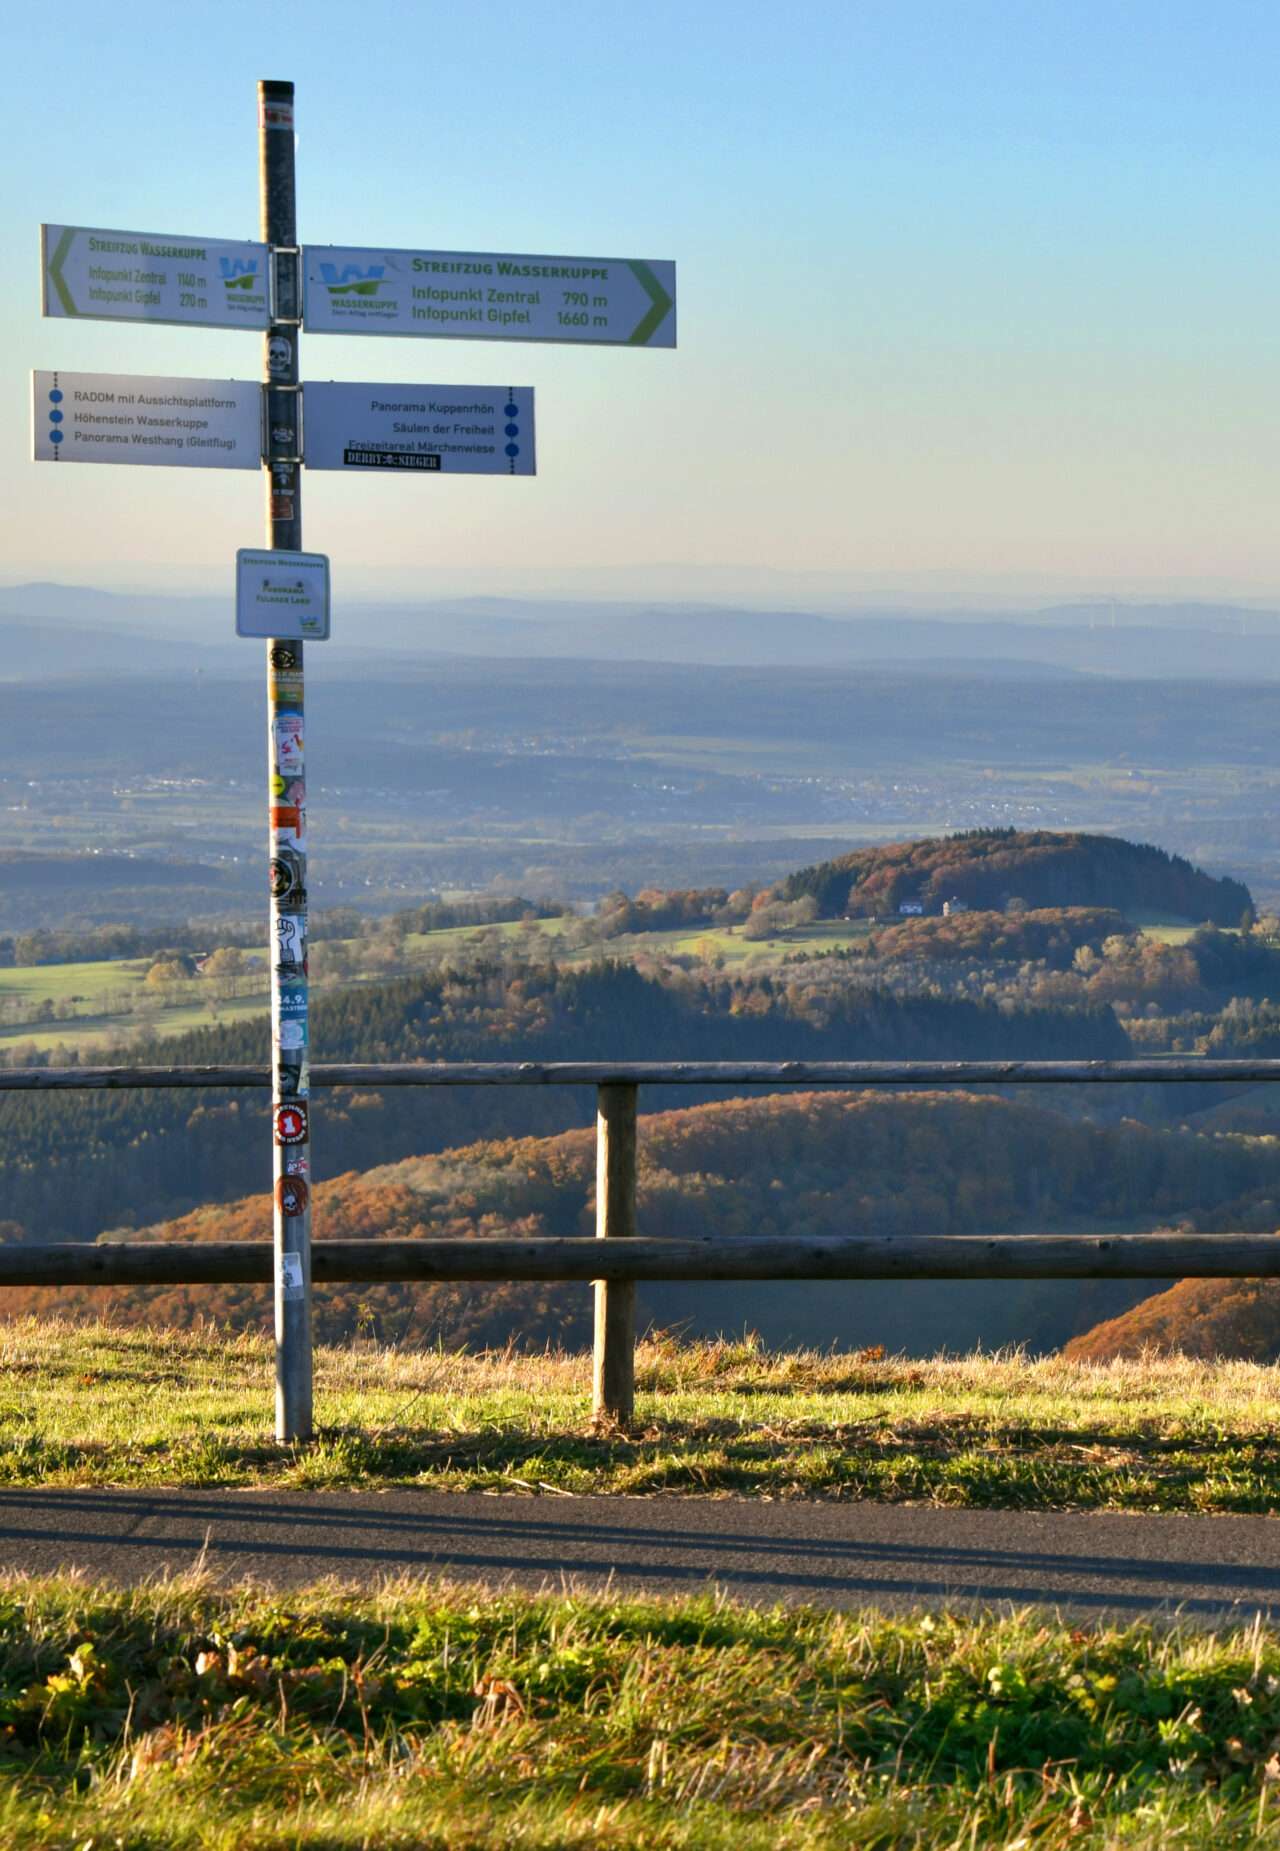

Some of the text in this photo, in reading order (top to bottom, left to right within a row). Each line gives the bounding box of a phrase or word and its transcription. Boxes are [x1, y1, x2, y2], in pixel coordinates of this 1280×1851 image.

[412, 286, 608, 307] Infopunkt Zentral 790 m
[412, 306, 482, 323] Infopunkt
[487, 308, 530, 326] Gipfel
[558, 311, 589, 326] 1660
[593, 315, 608, 326] m
[74, 391, 236, 409] RADOM mit Aussichtsplattform
[370, 401, 495, 415] Panorama Kuppenrhön
[74, 412, 208, 430] Höhenstein Wasserkuppe
[393, 422, 495, 435] Säulen der Freiheit
[74, 431, 237, 450] Panorama Westhang (Gleitflug)
[348, 440, 496, 454] Freizeitareal Märchenwiese
